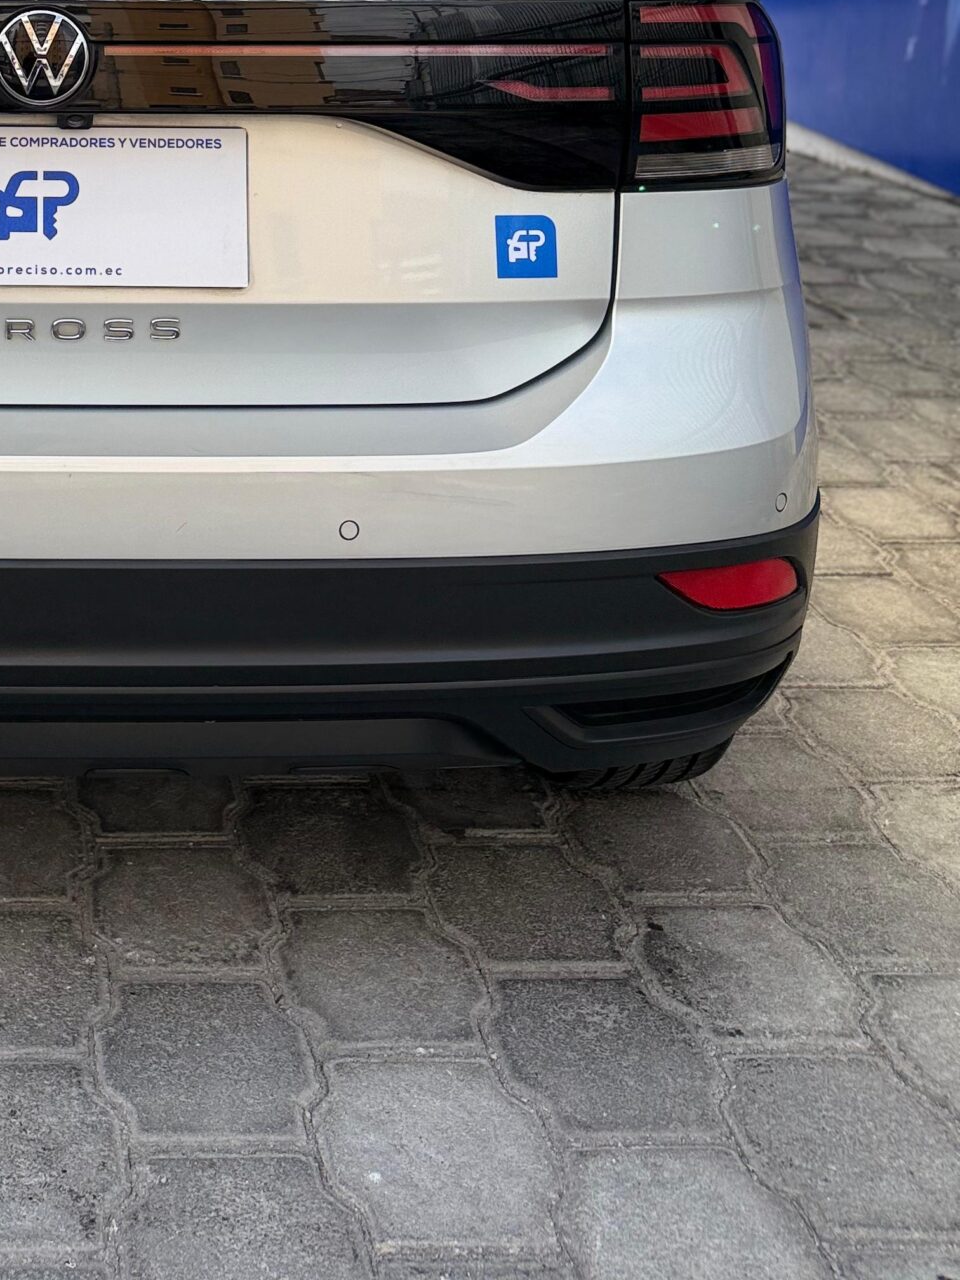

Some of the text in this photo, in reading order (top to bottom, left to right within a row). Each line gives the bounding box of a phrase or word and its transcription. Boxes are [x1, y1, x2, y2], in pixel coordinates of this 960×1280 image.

[10, 136, 116, 149] COMPRADORES
[118, 137, 127, 148] Y
[129, 137, 223, 150] VENDEDORES
